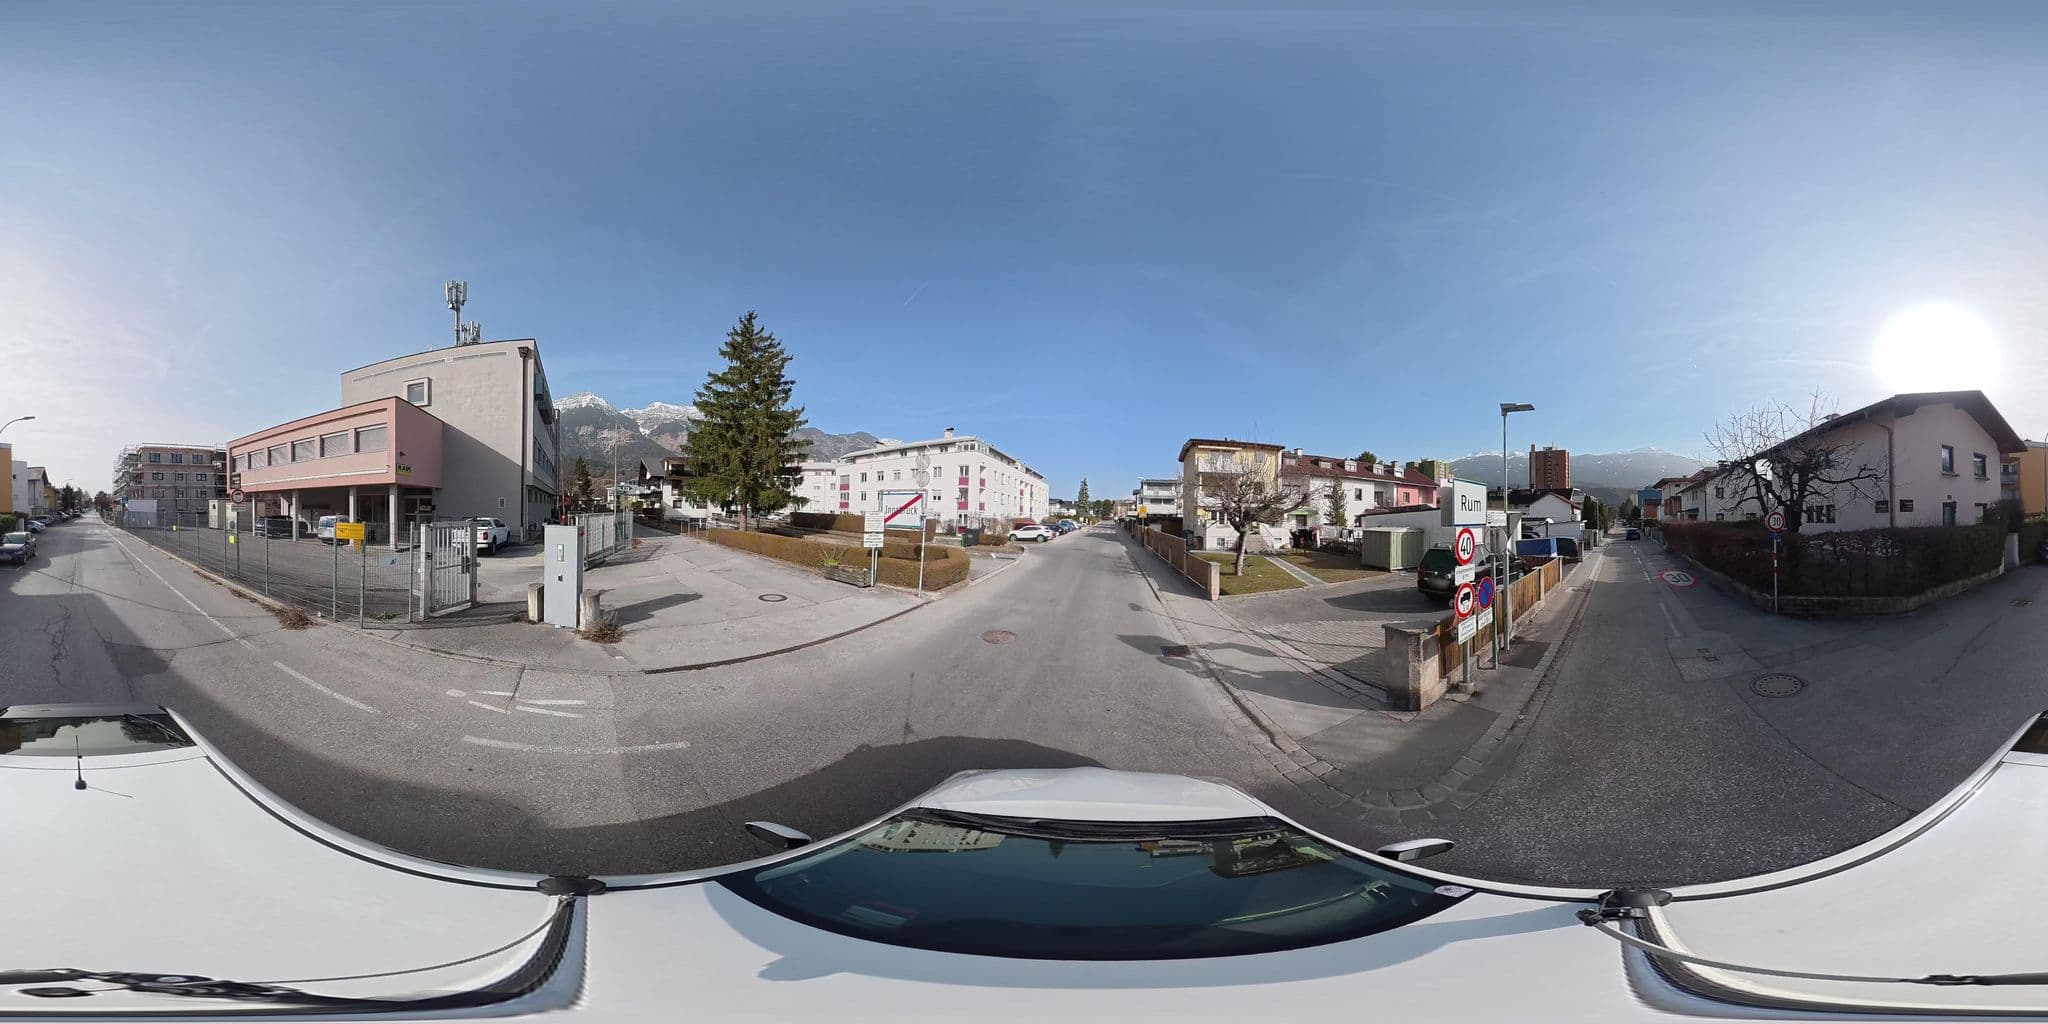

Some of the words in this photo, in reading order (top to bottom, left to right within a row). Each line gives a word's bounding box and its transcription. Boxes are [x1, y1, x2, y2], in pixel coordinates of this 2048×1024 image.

[1461, 494, 1482, 512] Rum
[885, 504, 918, 515] Innruck
[1771, 516, 1781, 526] 30
[1461, 537, 1472, 556] 40
[1666, 573, 1690, 583] 30
